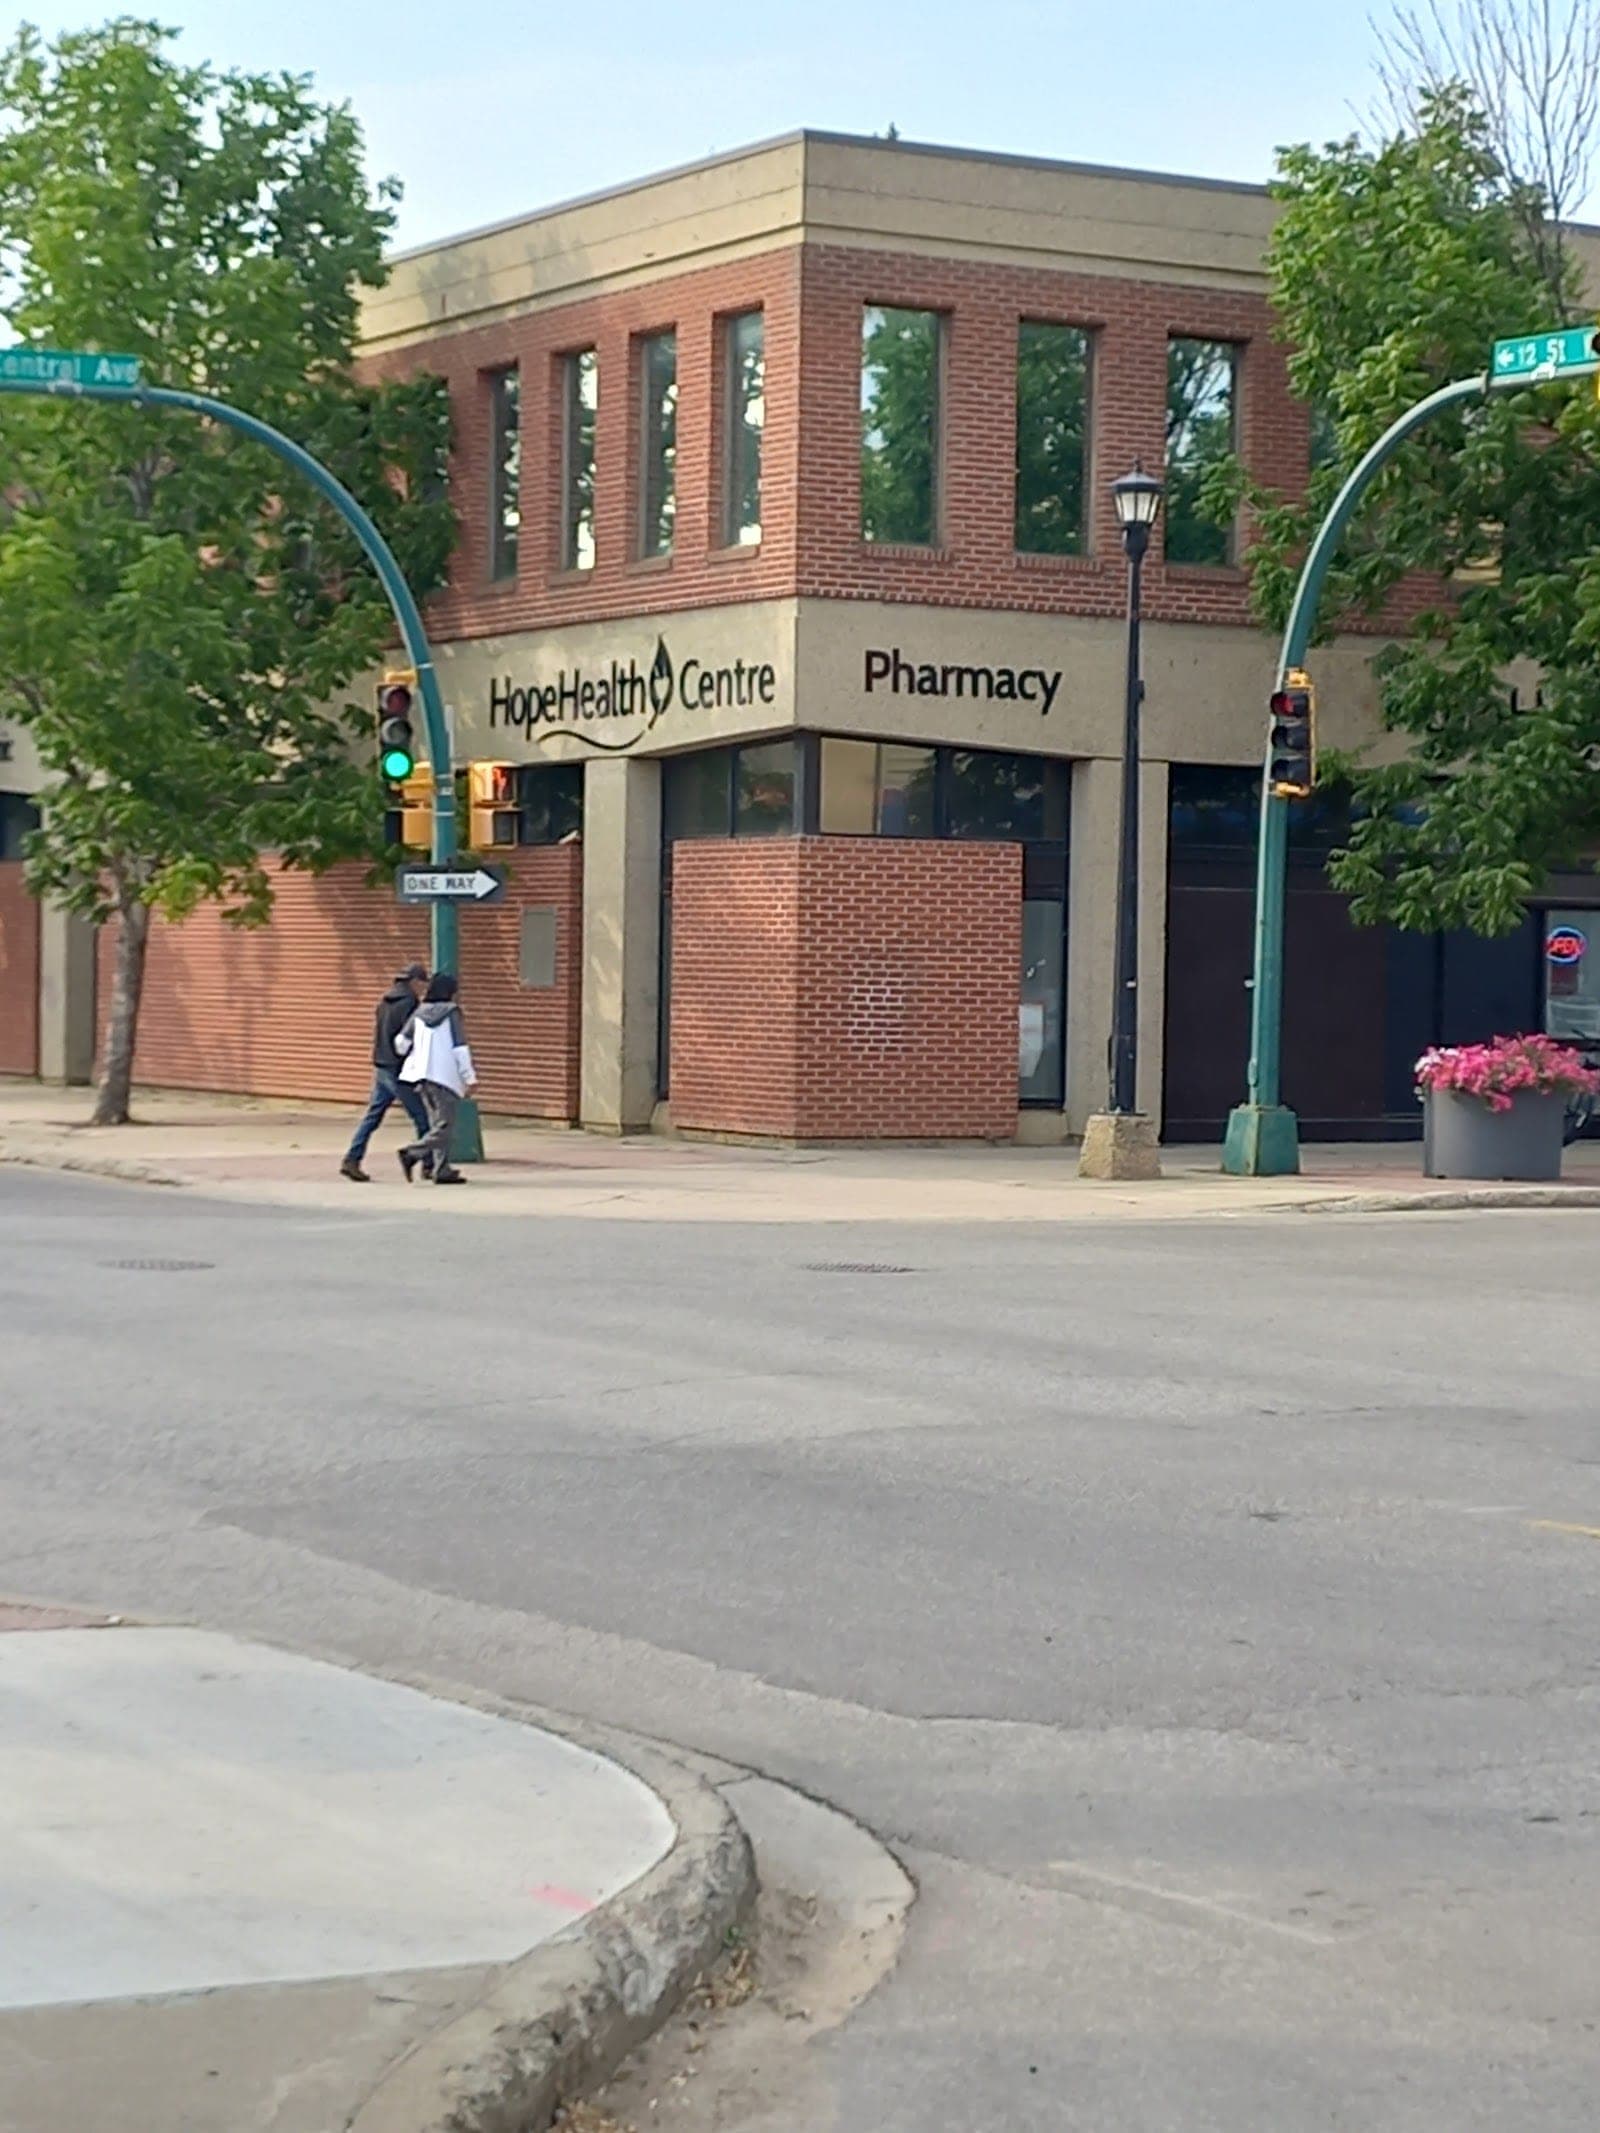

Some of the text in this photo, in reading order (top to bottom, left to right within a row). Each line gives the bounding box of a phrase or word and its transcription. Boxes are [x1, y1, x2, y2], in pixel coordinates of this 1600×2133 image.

[1518, 342, 1537, 366] 12
[0, 355, 144, 383] entral Ave
[679, 657, 776, 711] Centre
[864, 648, 1062, 716] Pharmacy
[407, 875, 475, 891] ONE WAY
